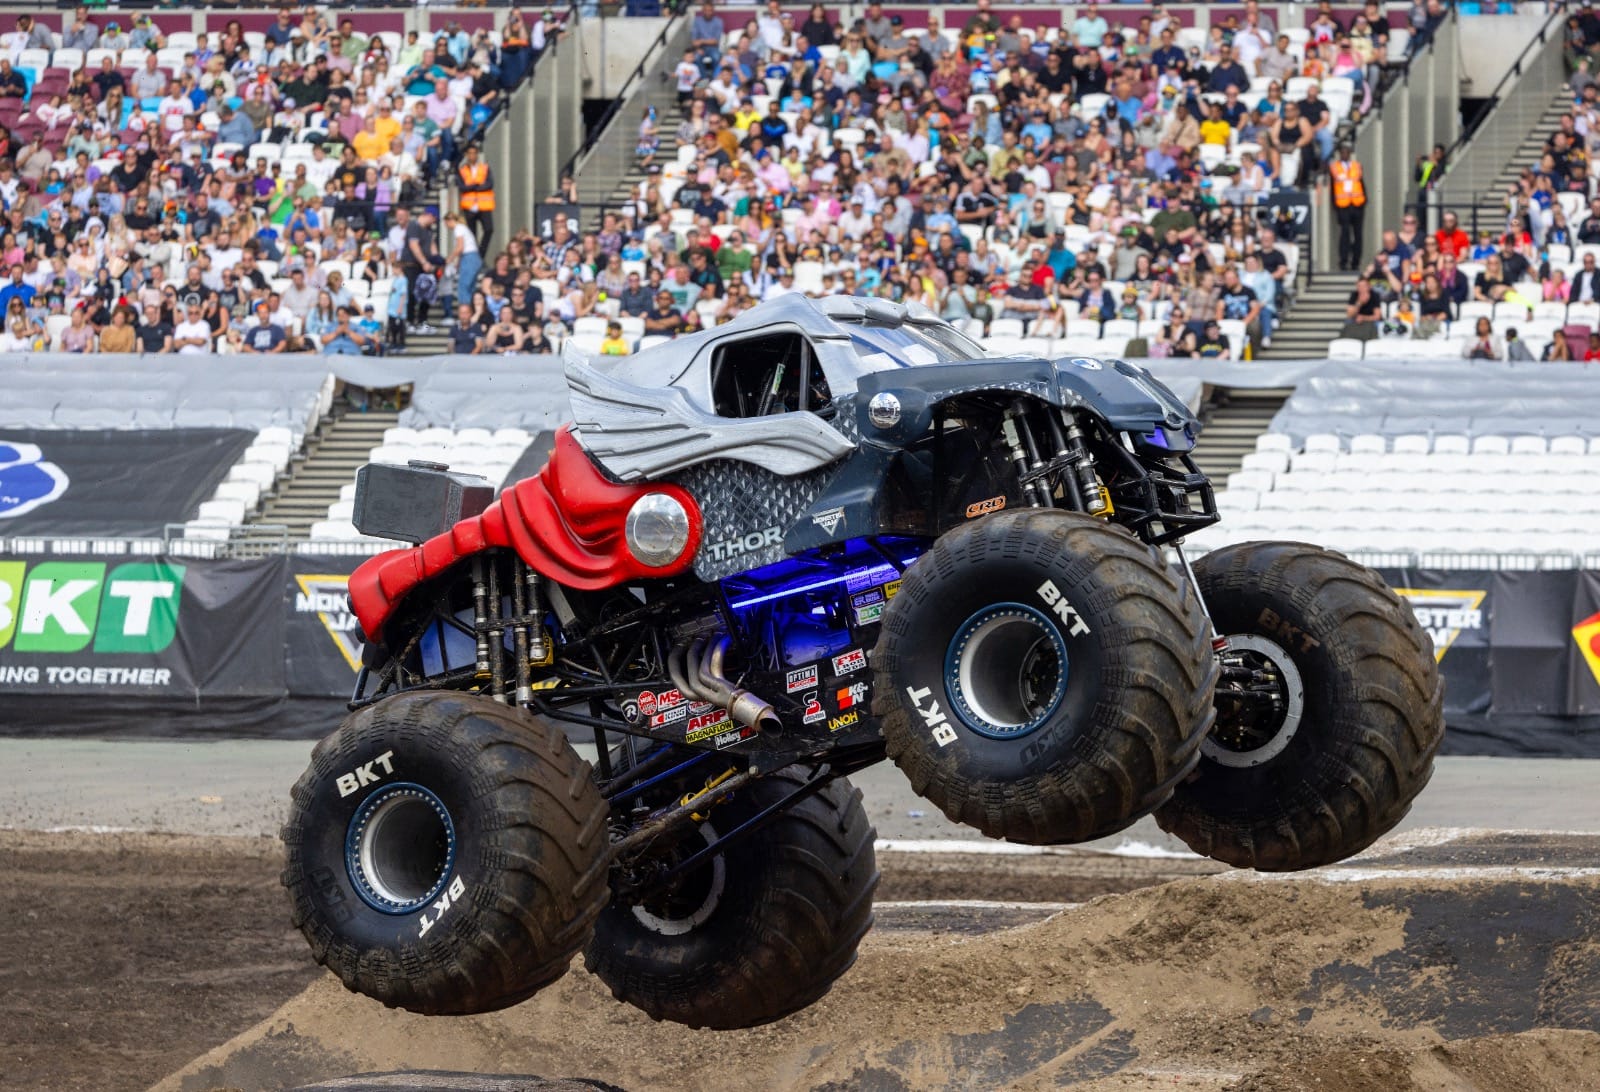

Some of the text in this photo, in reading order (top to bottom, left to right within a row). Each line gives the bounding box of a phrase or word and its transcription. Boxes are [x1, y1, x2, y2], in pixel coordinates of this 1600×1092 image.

[706, 525, 784, 563] THOR
[0, 579, 175, 636] KT
[1036, 579, 1091, 637] BKT
[1258, 607, 1321, 654] BKT
[46, 666, 171, 685] TOGETHER
[789, 668, 816, 682] OPTIMA
[665, 706, 686, 720] KING
[687, 721, 732, 742] MAGNAFLOW
[688, 709, 727, 731] ARP
[828, 711, 859, 730] UNOH
[906, 684, 959, 747] BKT
[336, 750, 394, 798] BKT
[418, 874, 466, 938] BKT
